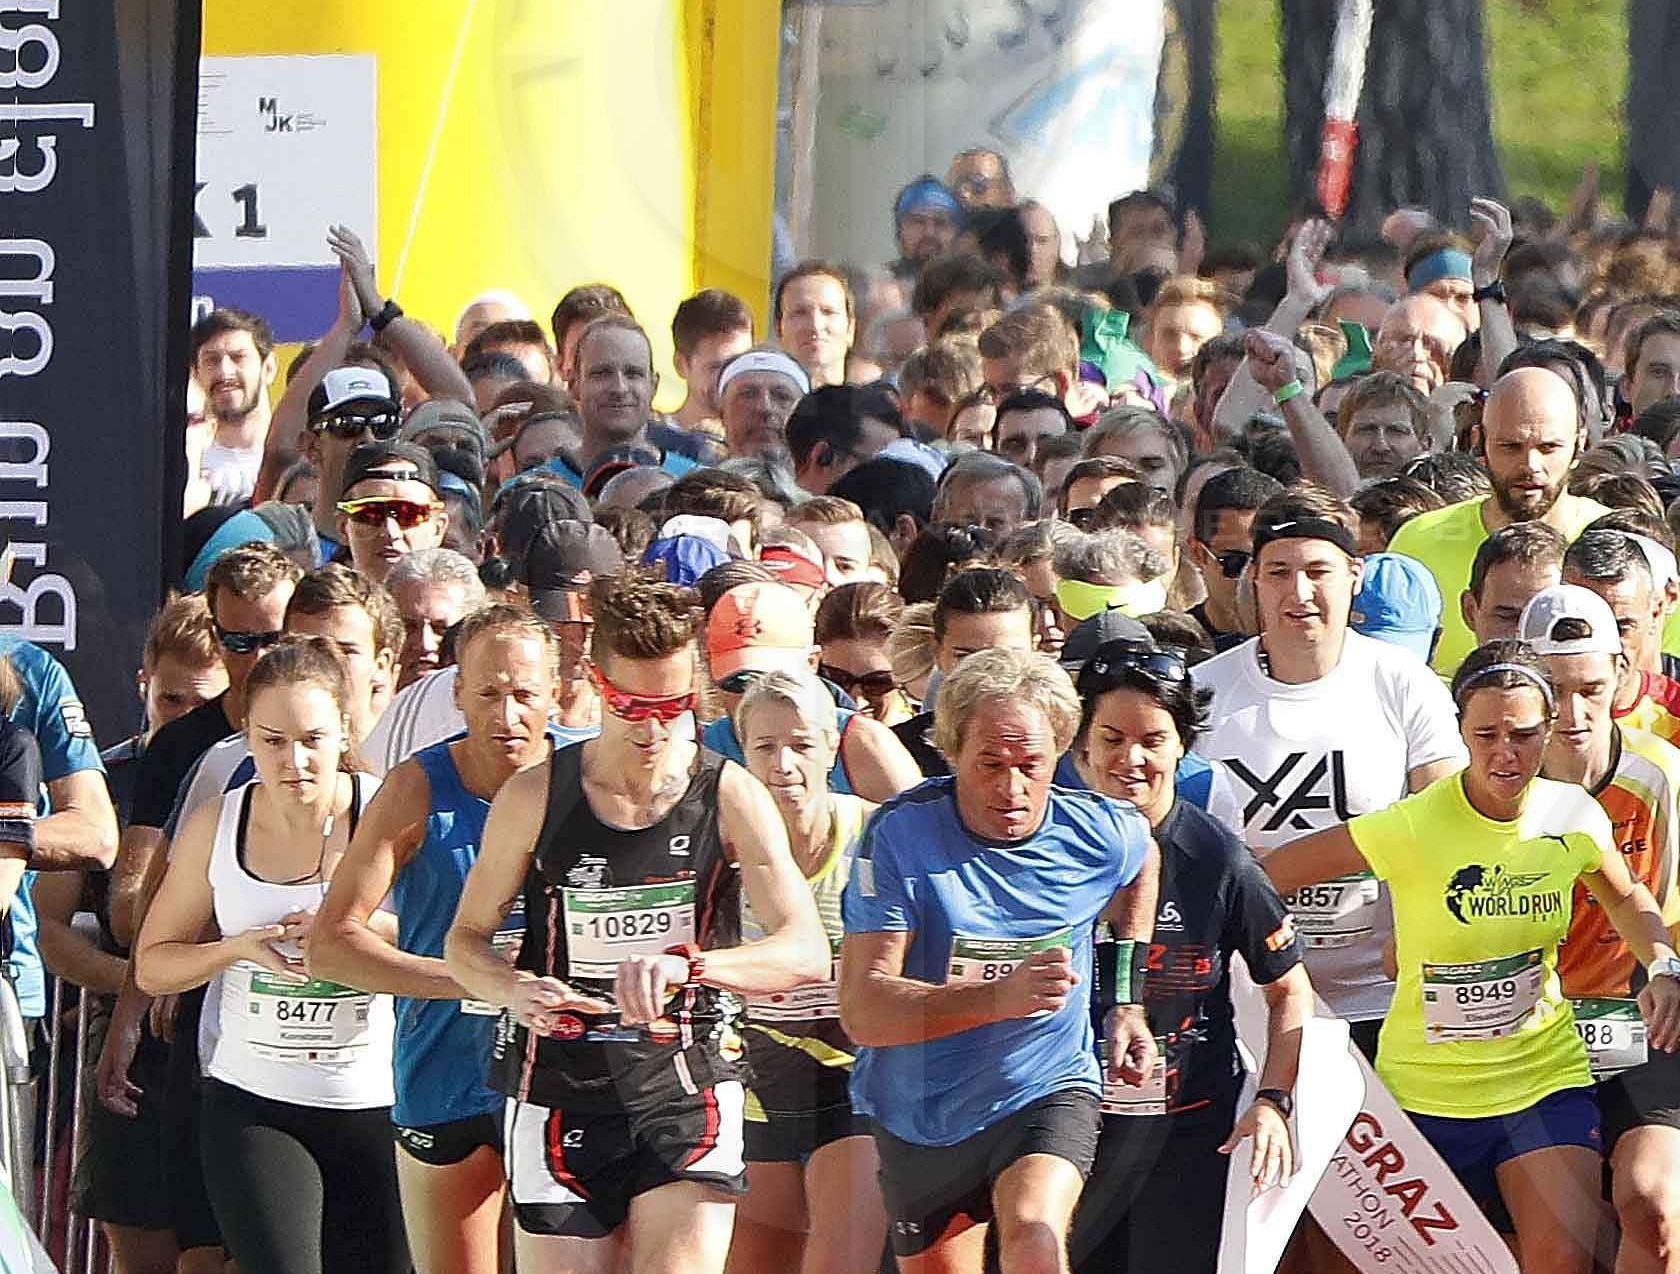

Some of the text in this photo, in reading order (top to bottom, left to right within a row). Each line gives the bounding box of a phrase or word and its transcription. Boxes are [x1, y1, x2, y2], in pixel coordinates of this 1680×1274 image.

[231, 182, 268, 238] 1
[1468, 891, 1561, 917] WORLD RUN
[588, 911, 672, 939] 10829
[276, 1000, 338, 1022] 8477
[1455, 980, 1517, 1004] 8949
[1331, 1151, 1395, 1233] ATHON
[1343, 1110, 1461, 1248] GRAZ
[1341, 1210, 1394, 1265] 2018
